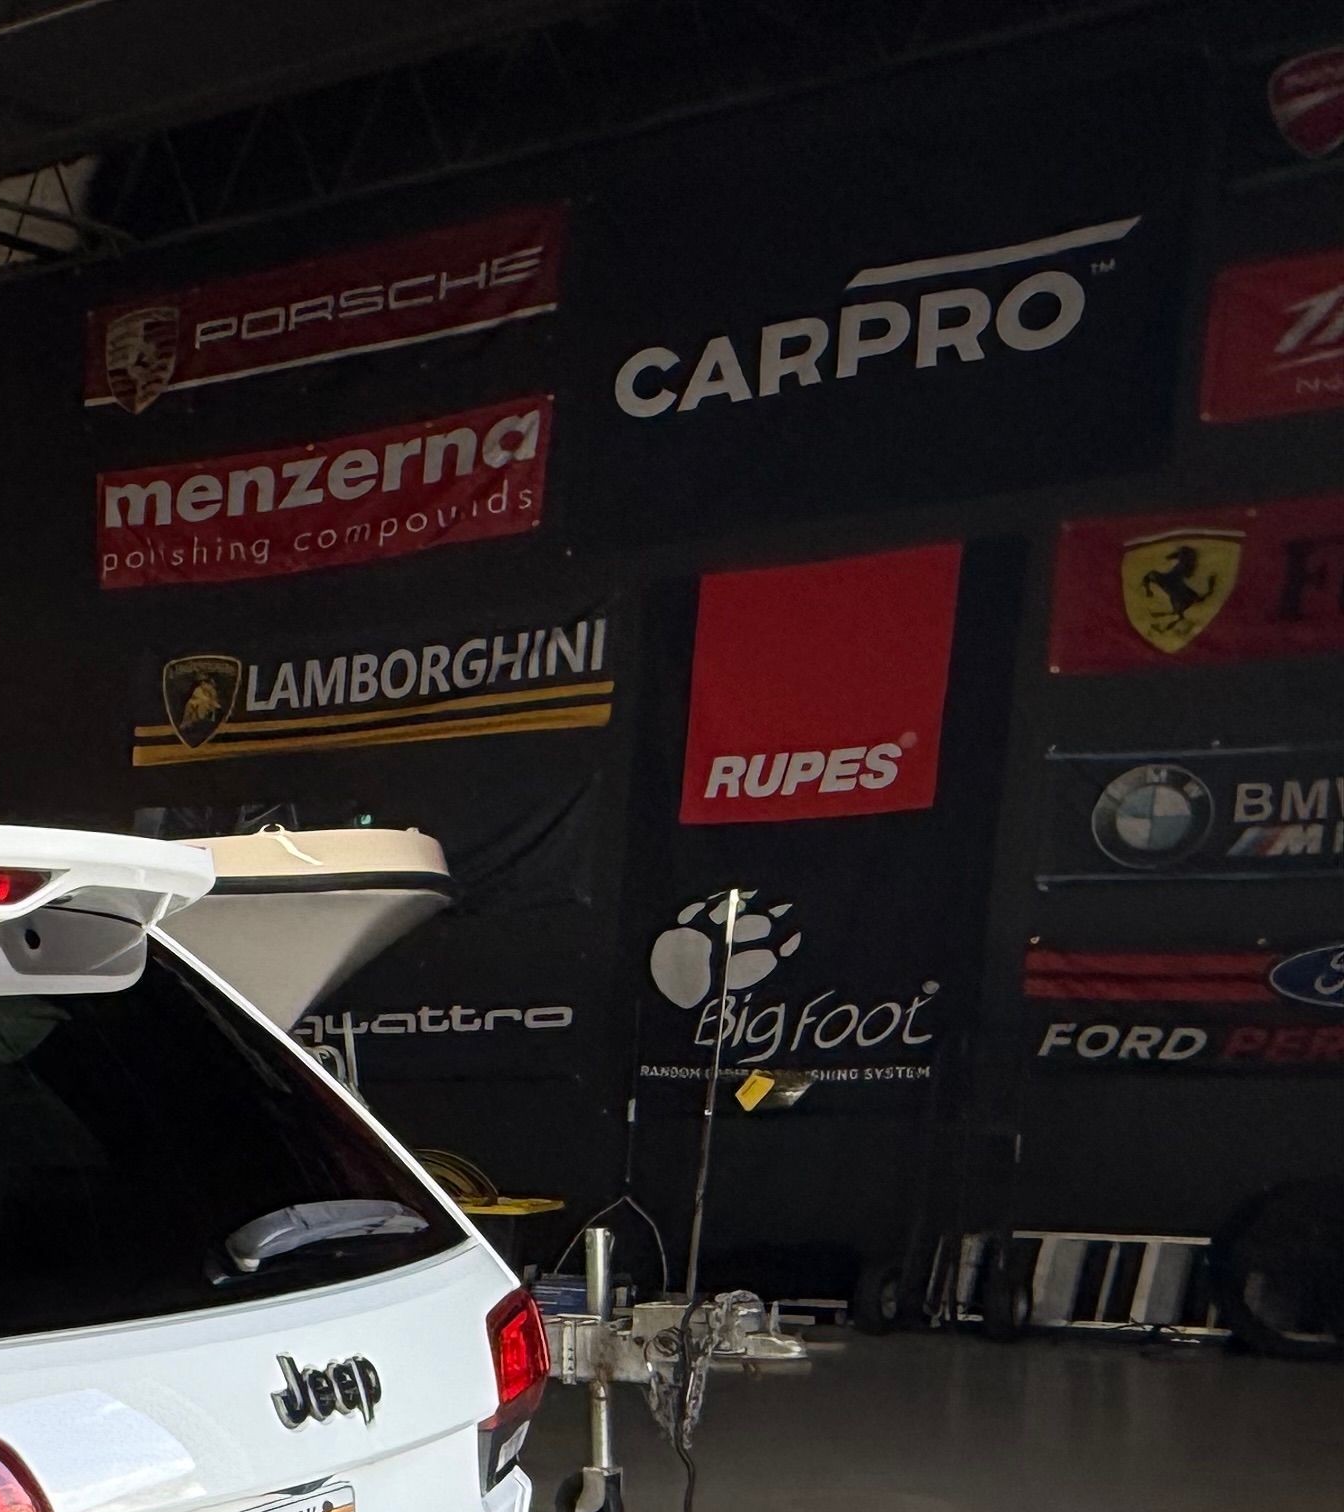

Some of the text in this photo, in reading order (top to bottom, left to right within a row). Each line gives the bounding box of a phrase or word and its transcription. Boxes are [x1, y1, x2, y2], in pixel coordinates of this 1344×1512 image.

[194, 245, 544, 350] PORSCHE
[614, 269, 1086, 419] CARPRO
[103, 409, 541, 528] menzerna
[245, 618, 607, 712] LAMBORGHINI
[703, 742, 903, 799] RUPES
[1232, 776, 1344, 824] BM
[293, 1004, 574, 1044] quattro
[1036, 1022, 1208, 1061] FORD
[863, 1064, 931, 1081] SYSTEM
[271, 1352, 382, 1430] Jeep
